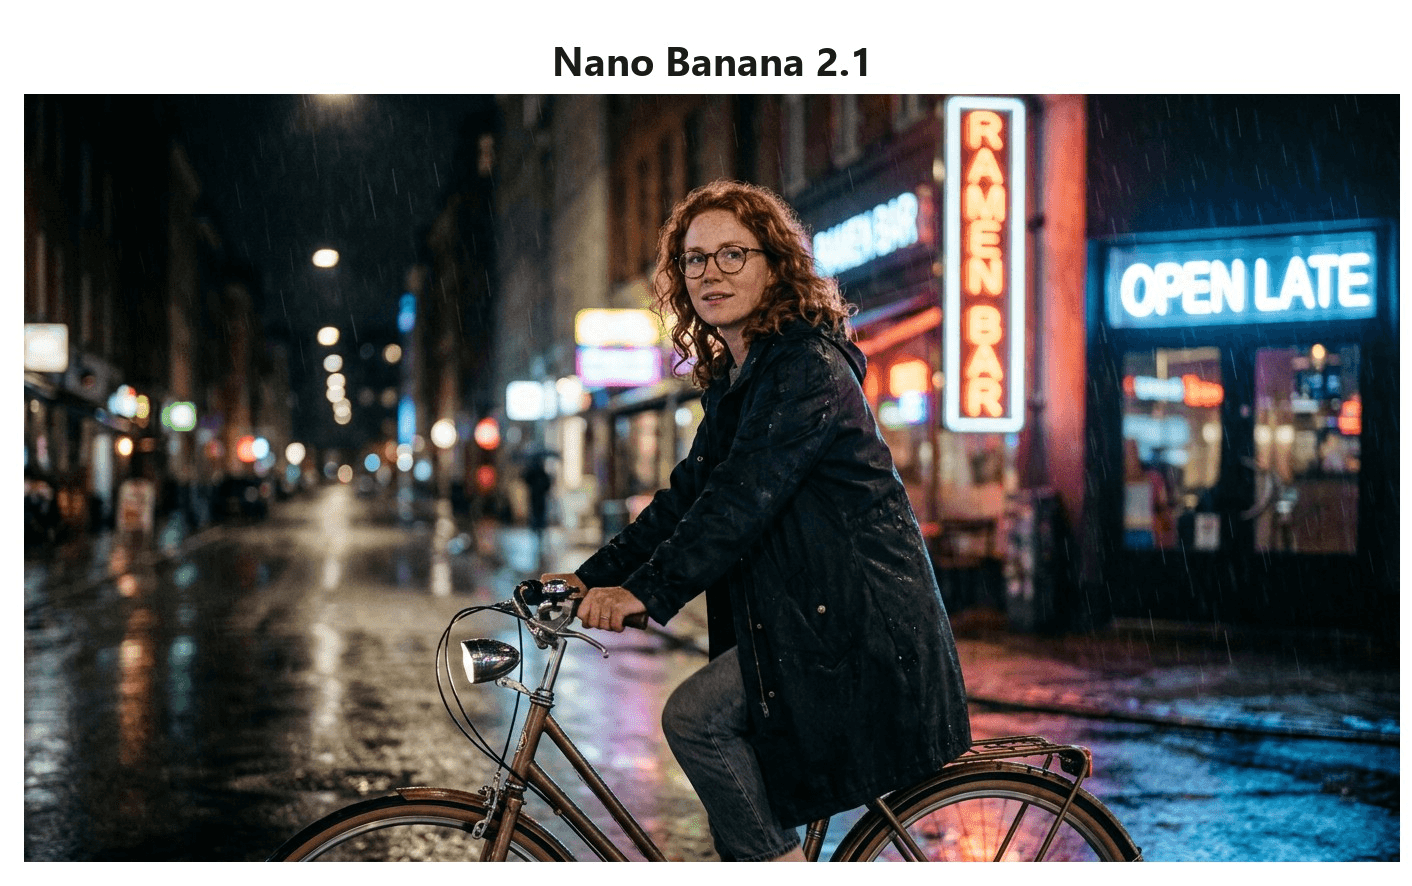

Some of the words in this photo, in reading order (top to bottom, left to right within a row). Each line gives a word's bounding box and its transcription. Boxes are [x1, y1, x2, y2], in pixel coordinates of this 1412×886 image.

[964, 110, 1005, 295] RAMEN
[1120, 258, 1245, 317] OPEN
[1254, 252, 1371, 311] LATE
[966, 304, 1003, 417] BAR
